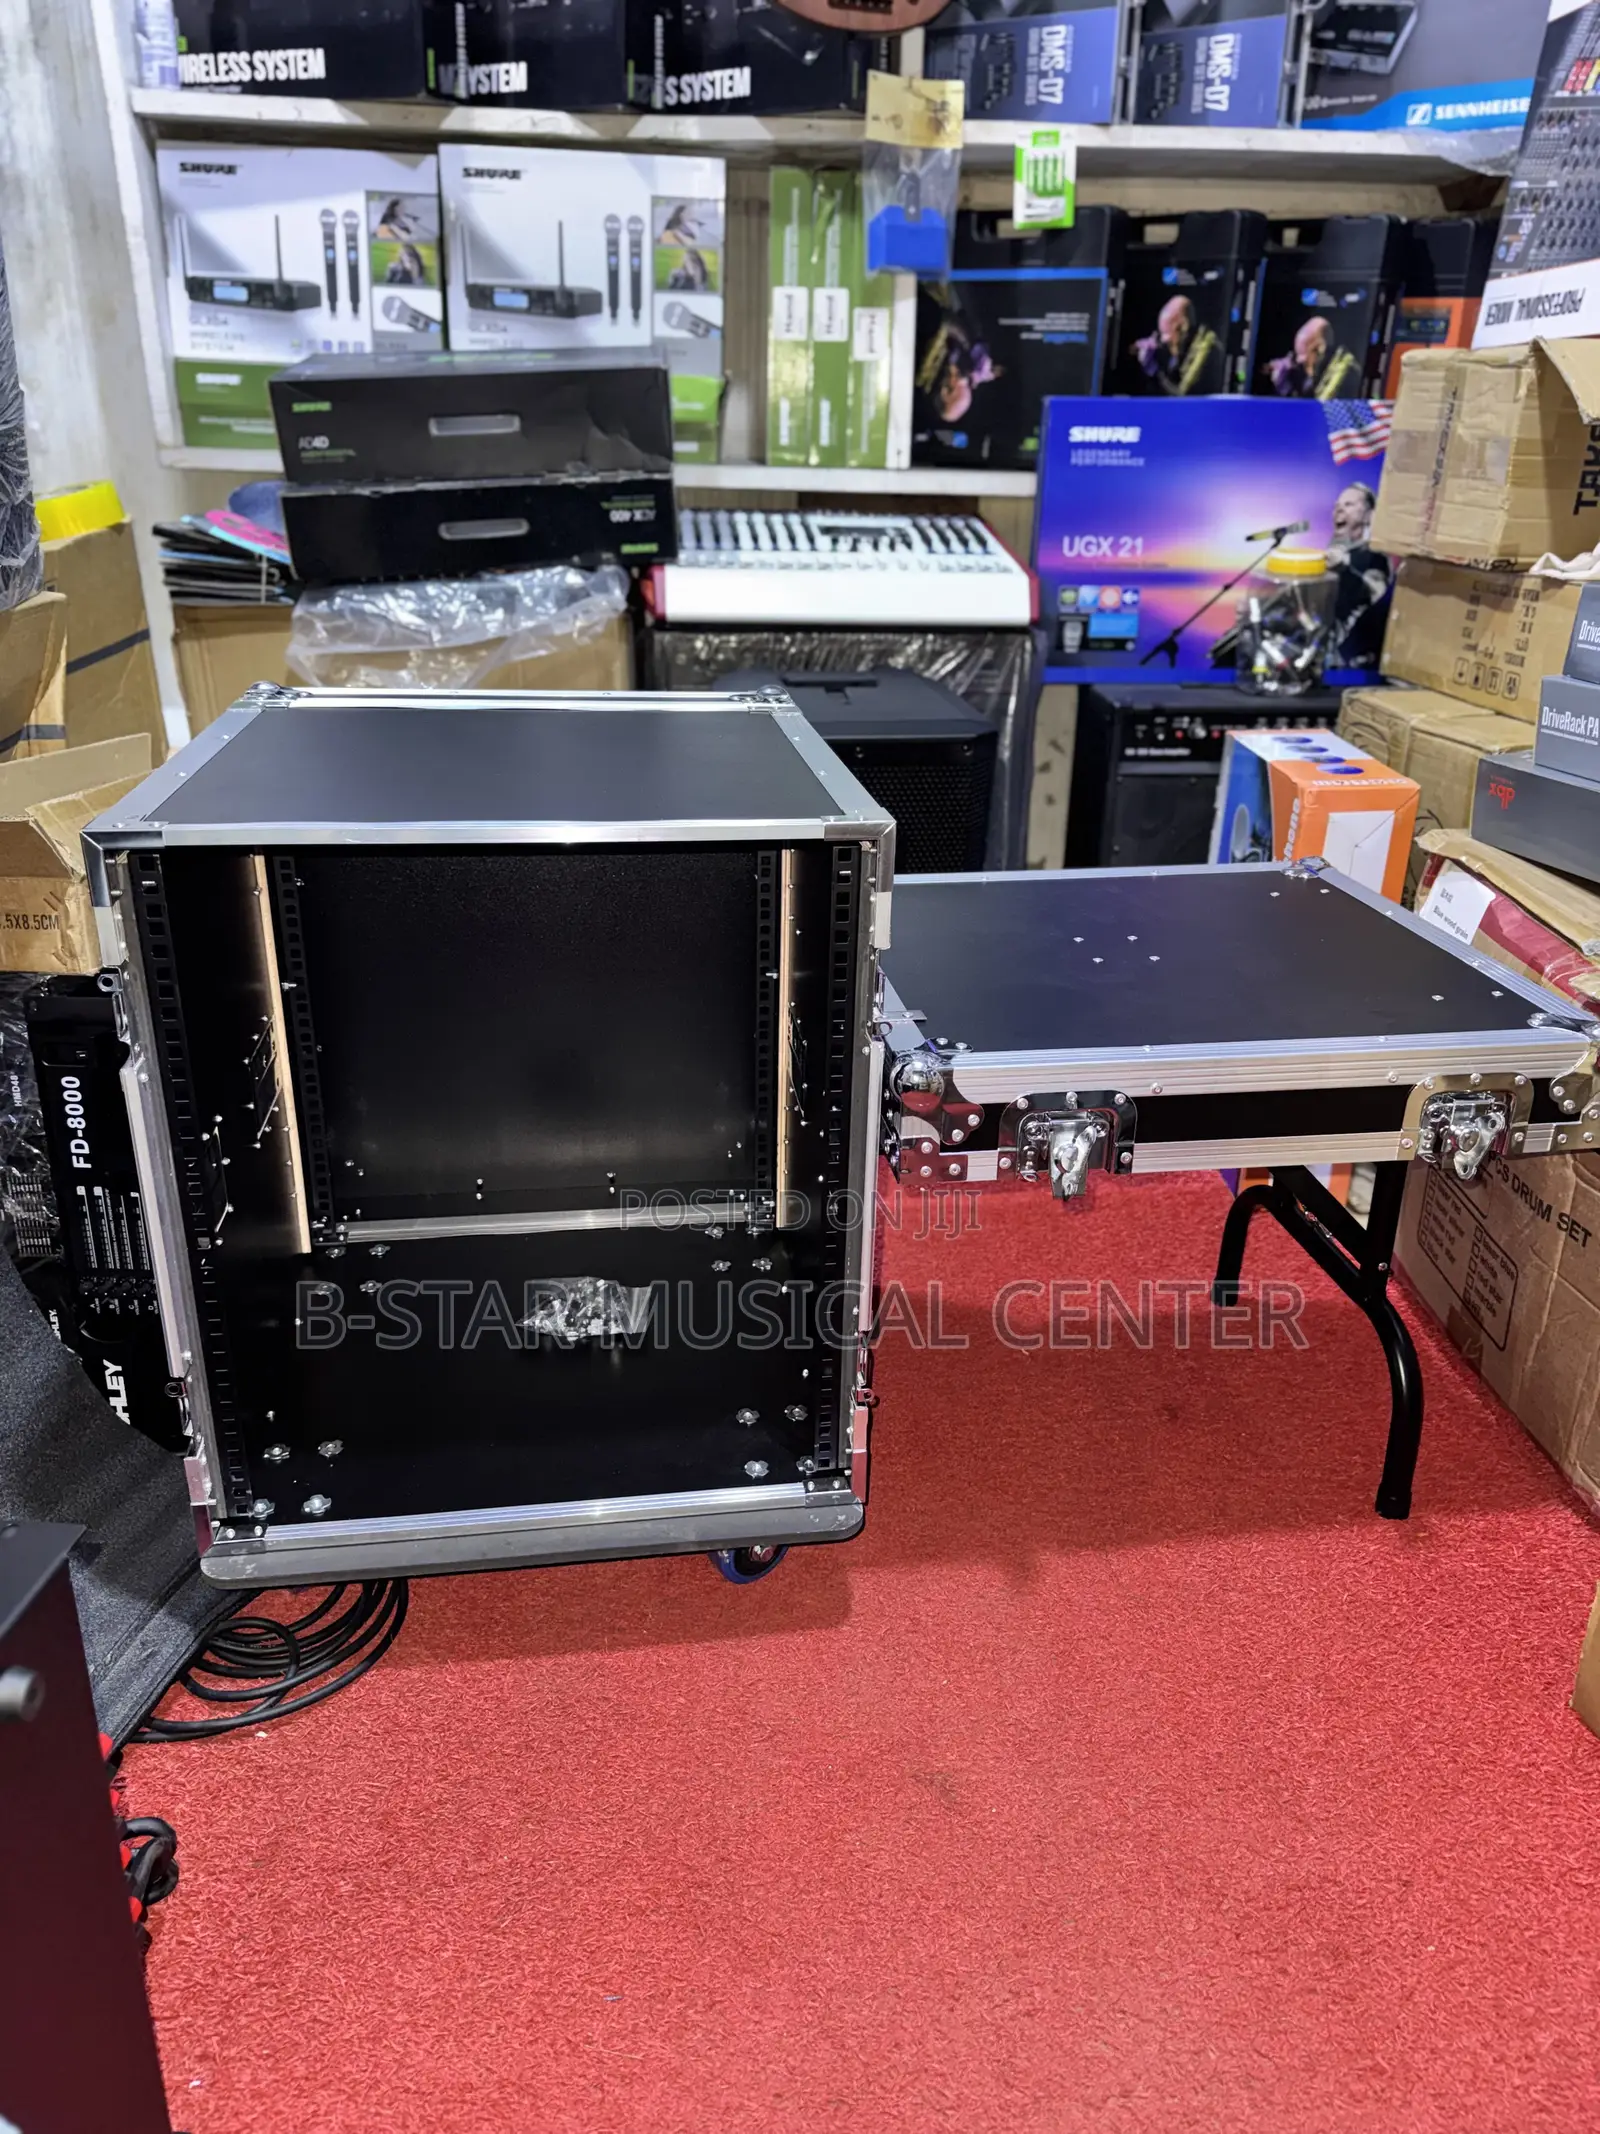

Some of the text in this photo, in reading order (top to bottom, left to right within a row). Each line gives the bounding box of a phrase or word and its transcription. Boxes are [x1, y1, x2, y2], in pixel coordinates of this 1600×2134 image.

[252, 48, 326, 82] SYSTEM
[1038, 24, 1067, 105] DMS-07
[1204, 33, 1235, 112] DMS-07
[680, 66, 751, 104] SYSTEM
[1435, 97, 1531, 120] SENNHEISE
[179, 162, 238, 175] SHURE
[462, 166, 522, 180] SHURE
[1068, 426, 1142, 443] SHURE
[1062, 536, 1144, 558] UGX 21
[1541, 706, 1586, 736] DriveRack
[0, 913, 60, 931] .5X8.5CM
[1455, 925, 1469, 941] grain
[11, 1075, 22, 1107] HMD48
[60, 1076, 92, 1169] FD-8000
[1511, 1173, 1553, 1223] DRUM
[1556, 1212, 1592, 1248] SET
